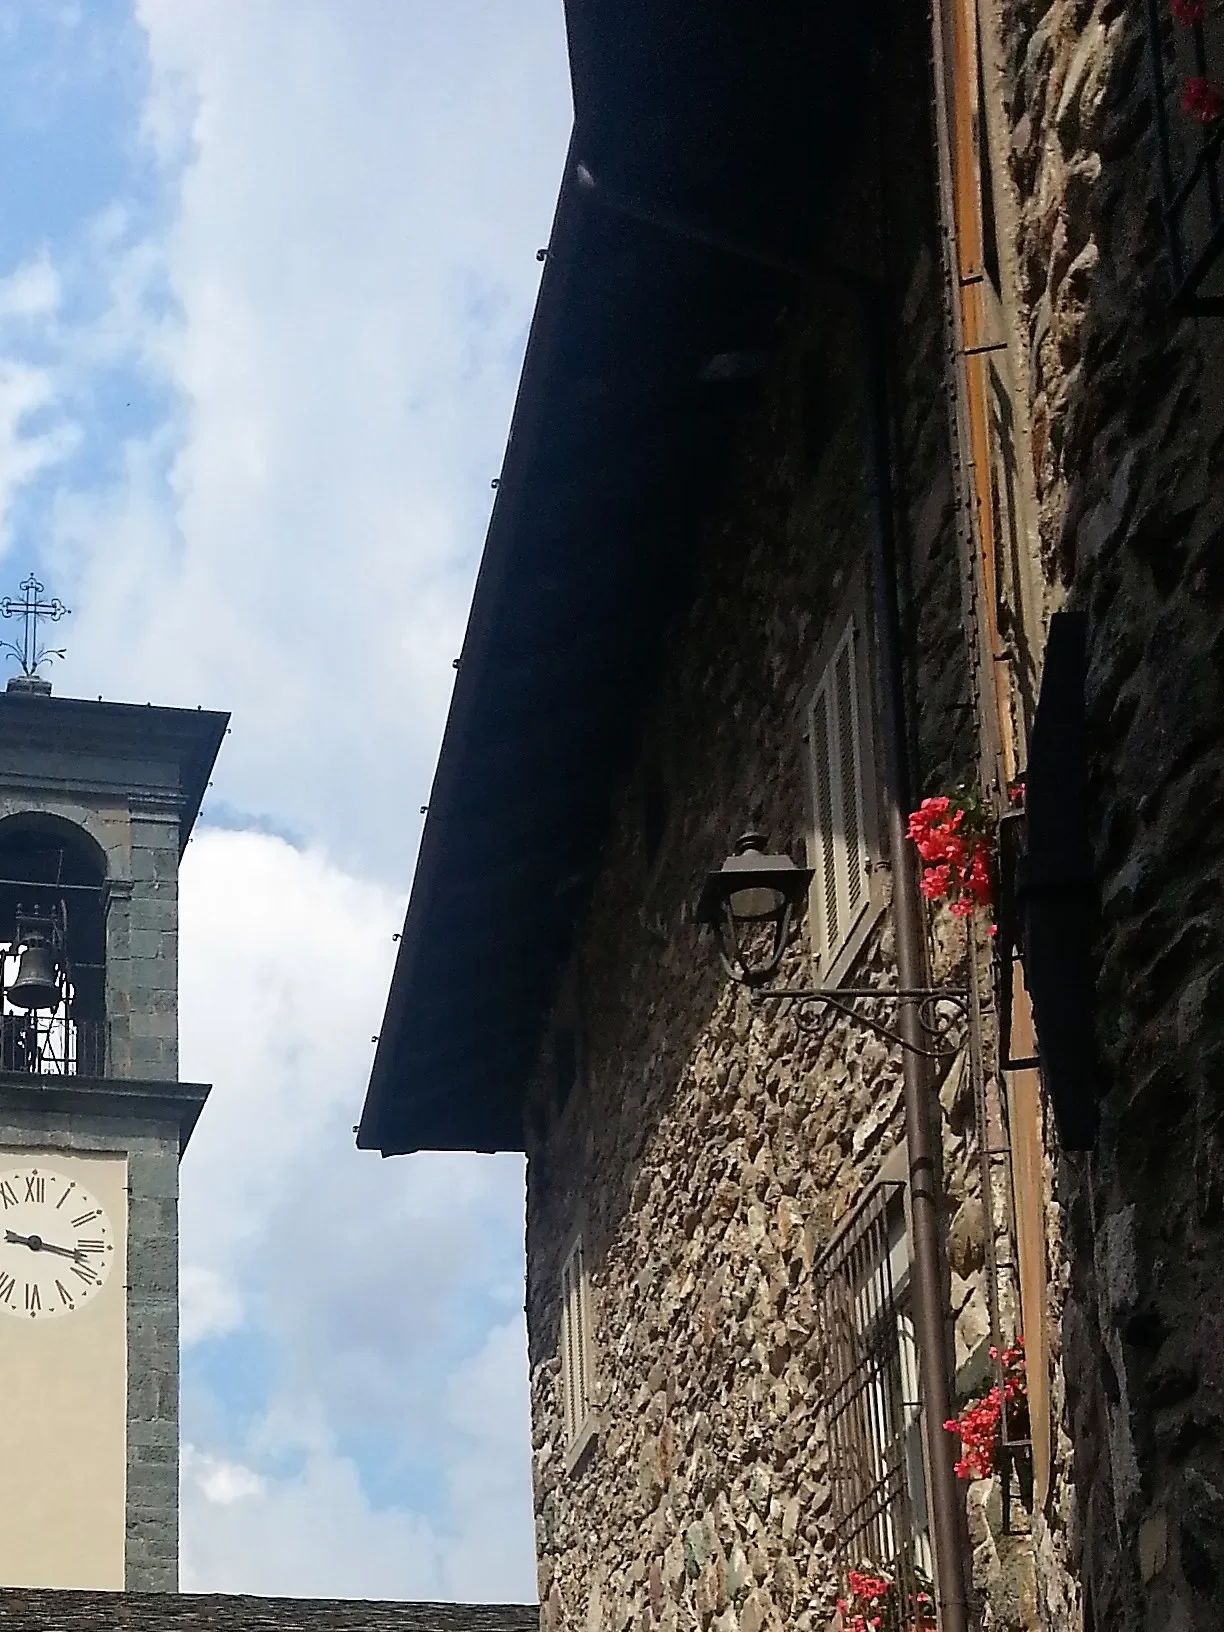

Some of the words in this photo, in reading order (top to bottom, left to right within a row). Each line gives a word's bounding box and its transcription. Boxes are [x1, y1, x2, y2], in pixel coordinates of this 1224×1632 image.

[25, 1177, 45, 1203] XII
[56, 1188, 71, 1209] I
[71, 1211, 97, 1228] II
[77, 1240, 105, 1253] III
[70, 1261, 98, 1286] IV
[25, 1283, 41, 1310] VI
[55, 1279, 73, 1305] V
